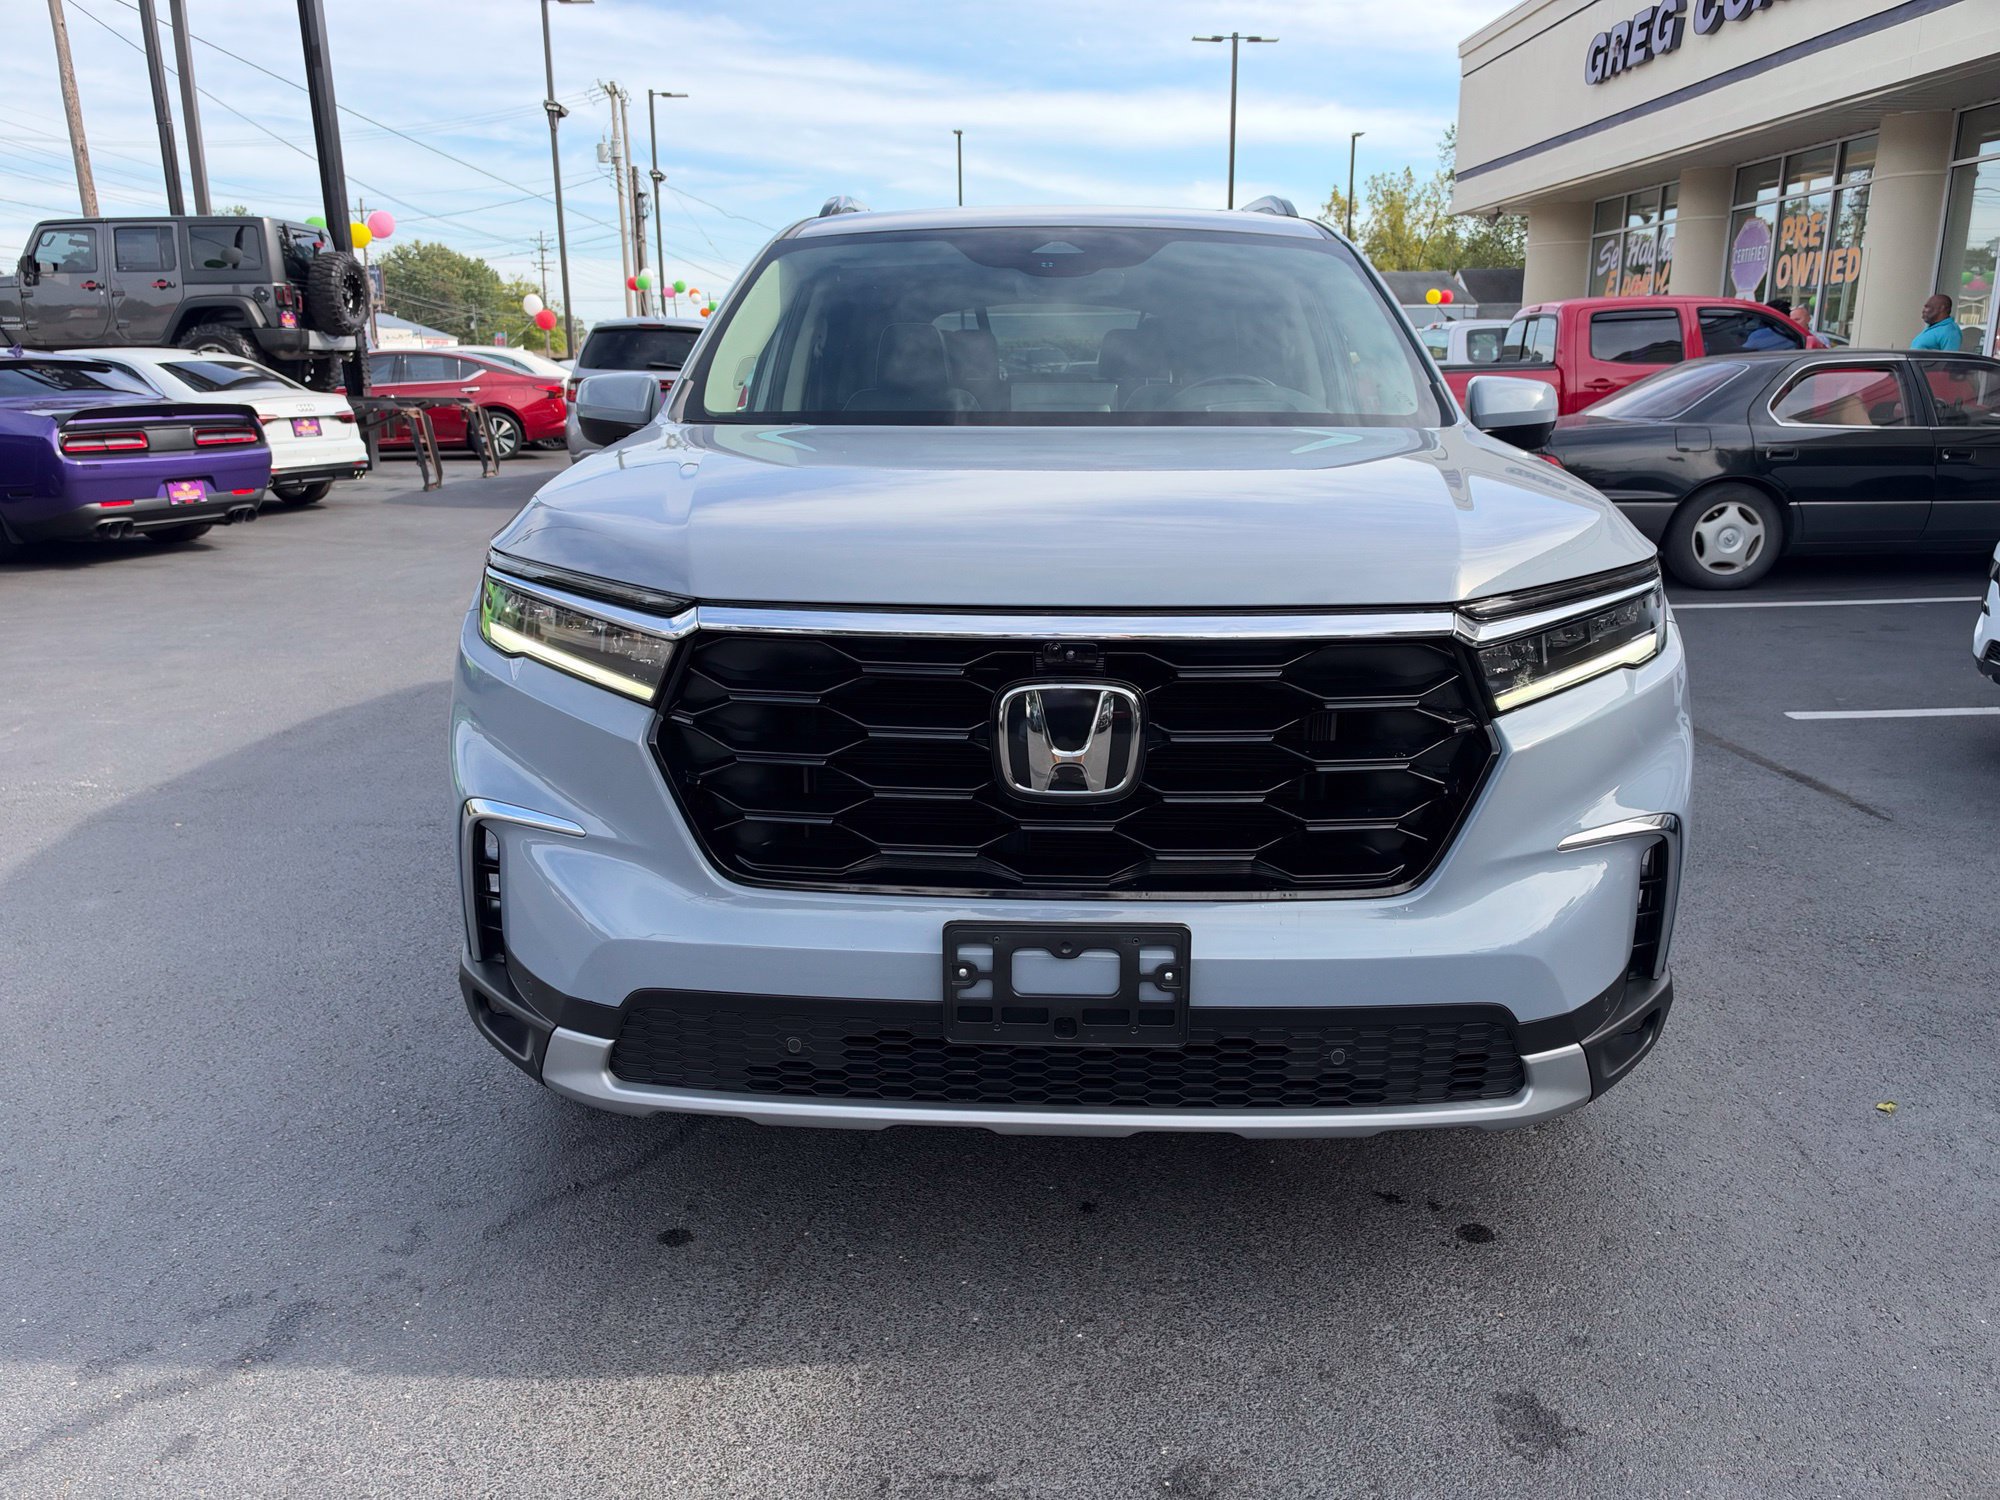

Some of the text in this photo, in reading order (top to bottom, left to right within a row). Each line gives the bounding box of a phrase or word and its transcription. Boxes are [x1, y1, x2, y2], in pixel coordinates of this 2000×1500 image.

[1585, 0, 1685, 85] GREG
[1597, 240, 1619, 276] Se
[1734, 245, 1768, 264] CERTIFIED
[1776, 246, 1860, 289] OWNED
